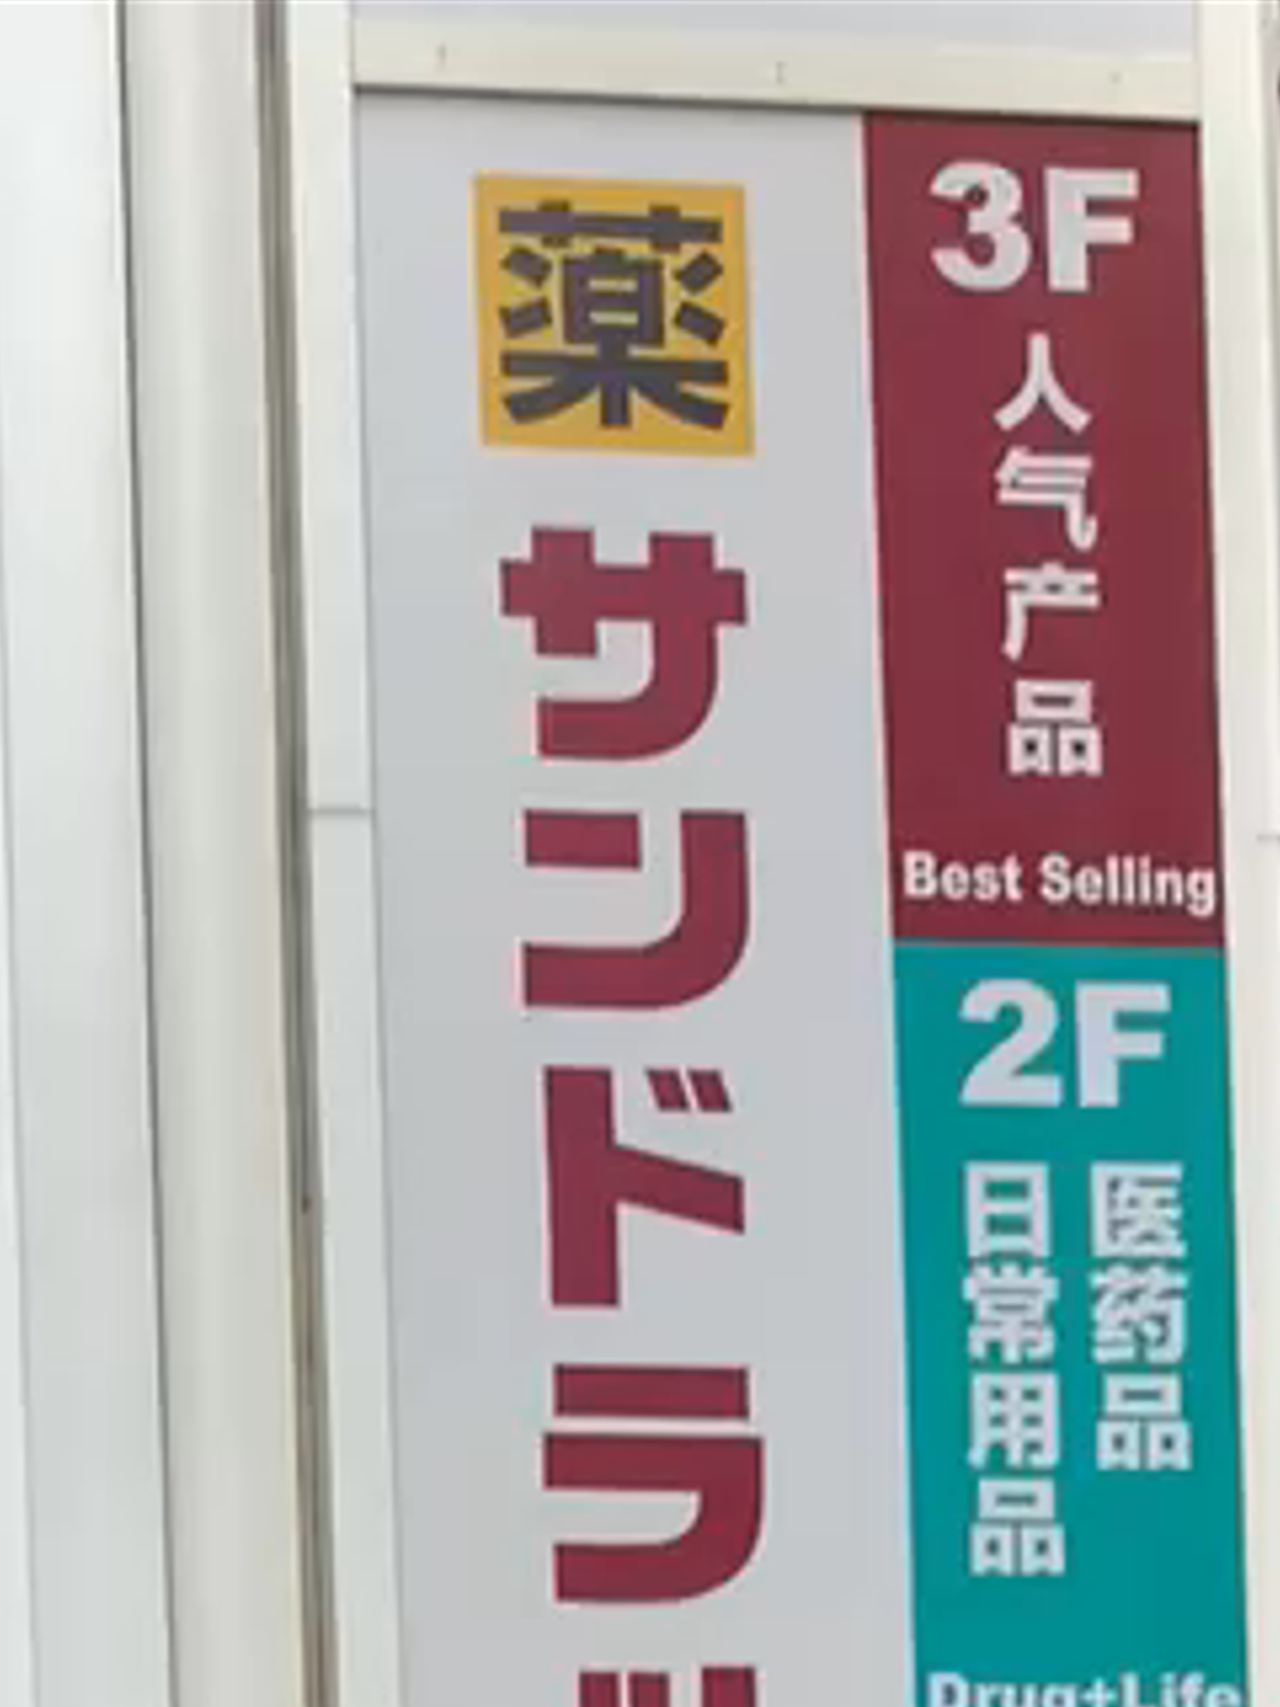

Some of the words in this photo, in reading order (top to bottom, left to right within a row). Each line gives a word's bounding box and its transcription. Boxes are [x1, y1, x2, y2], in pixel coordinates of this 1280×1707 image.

[497, 200, 731, 432] 薬
[929, 160, 1139, 293] 3F
[994, 332, 1105, 778] 人气产品
[903, 850, 1024, 904] Best
[1039, 852, 1218, 919] Selling
[958, 978, 1171, 1109] 2F
[962, 1161, 1067, 1577] 日常用品
[1089, 1161, 1194, 1472] 医药品
